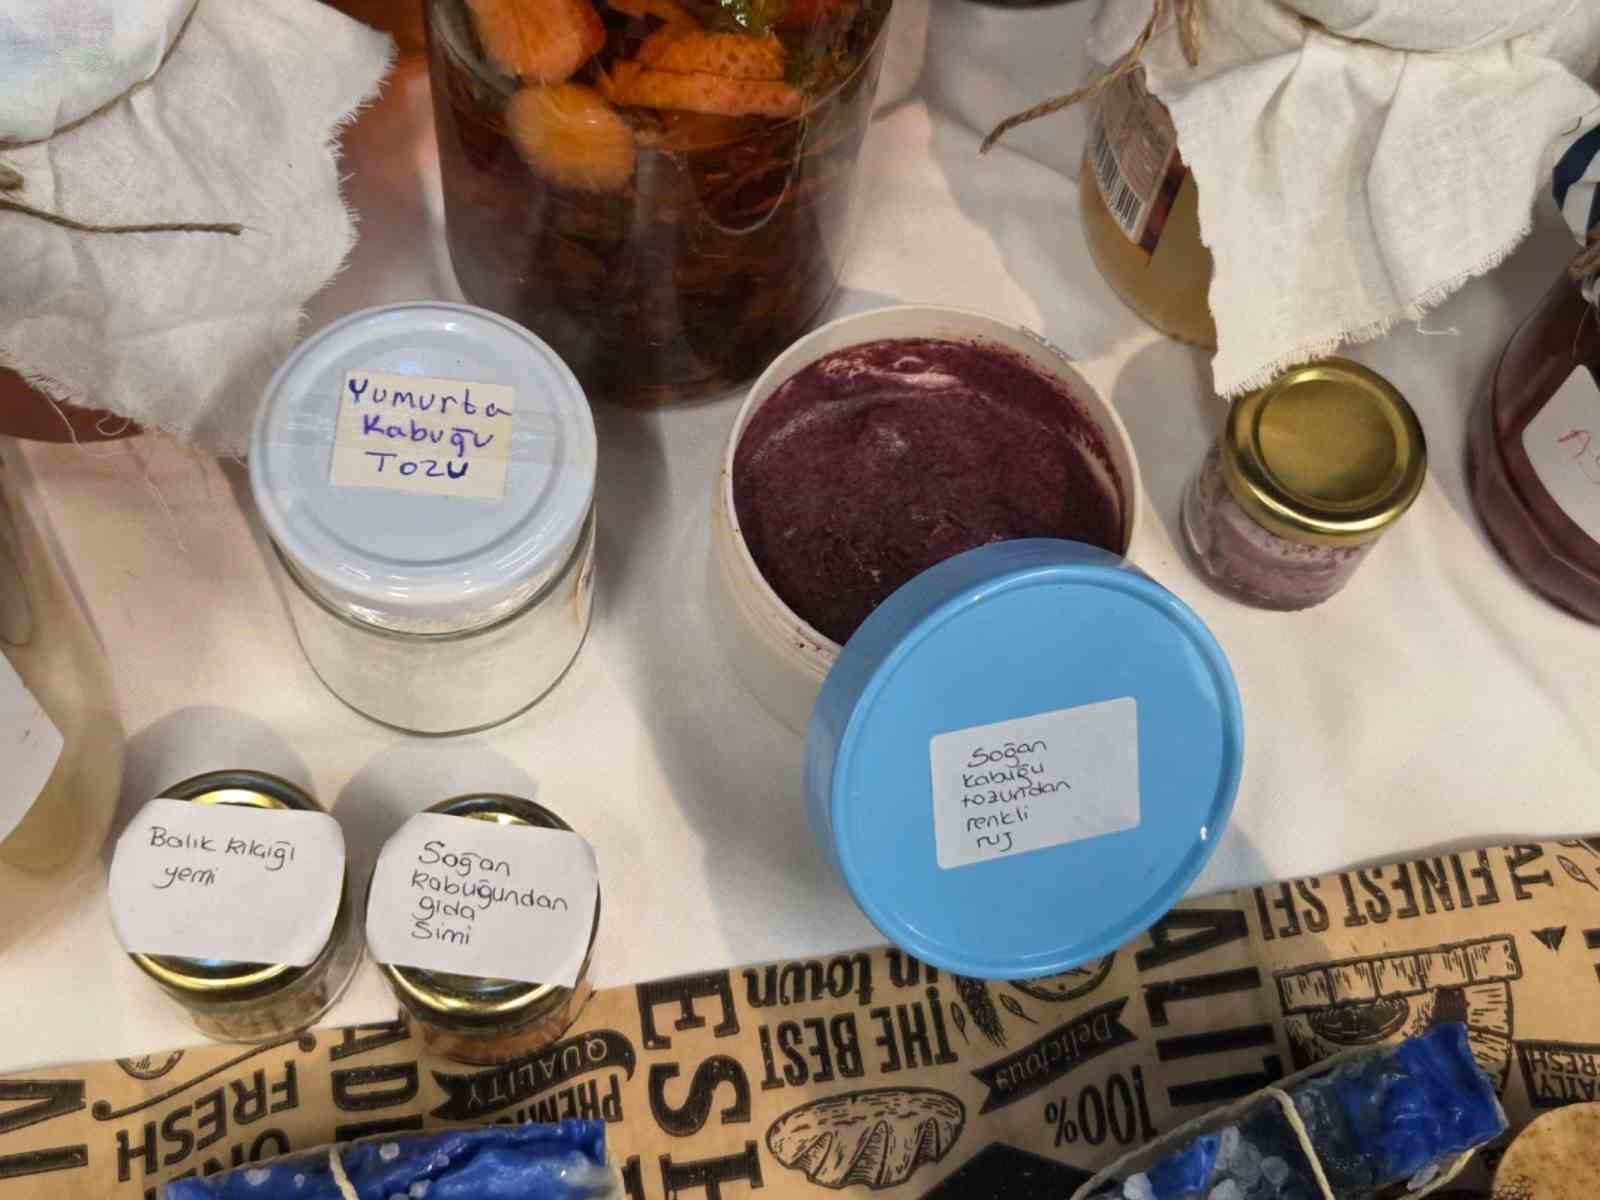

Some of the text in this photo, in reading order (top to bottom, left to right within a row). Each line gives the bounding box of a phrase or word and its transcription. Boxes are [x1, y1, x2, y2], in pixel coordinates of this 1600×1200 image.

[348, 378, 513, 418] Yumurta
[966, 804, 1029, 833] renkli
[151, 864, 220, 889] yemi
[418, 840, 511, 877] Soğan
[1336, 851, 1501, 928] FINEST
[742, 950, 873, 1008] town
[466, 1037, 609, 1107] QUALITY
[759, 1000, 959, 1091] THE BEST
[994, 1012, 1113, 1087] Delicious
[115, 1060, 299, 1183] FRESH
[1045, 1064, 1159, 1149] 100%
